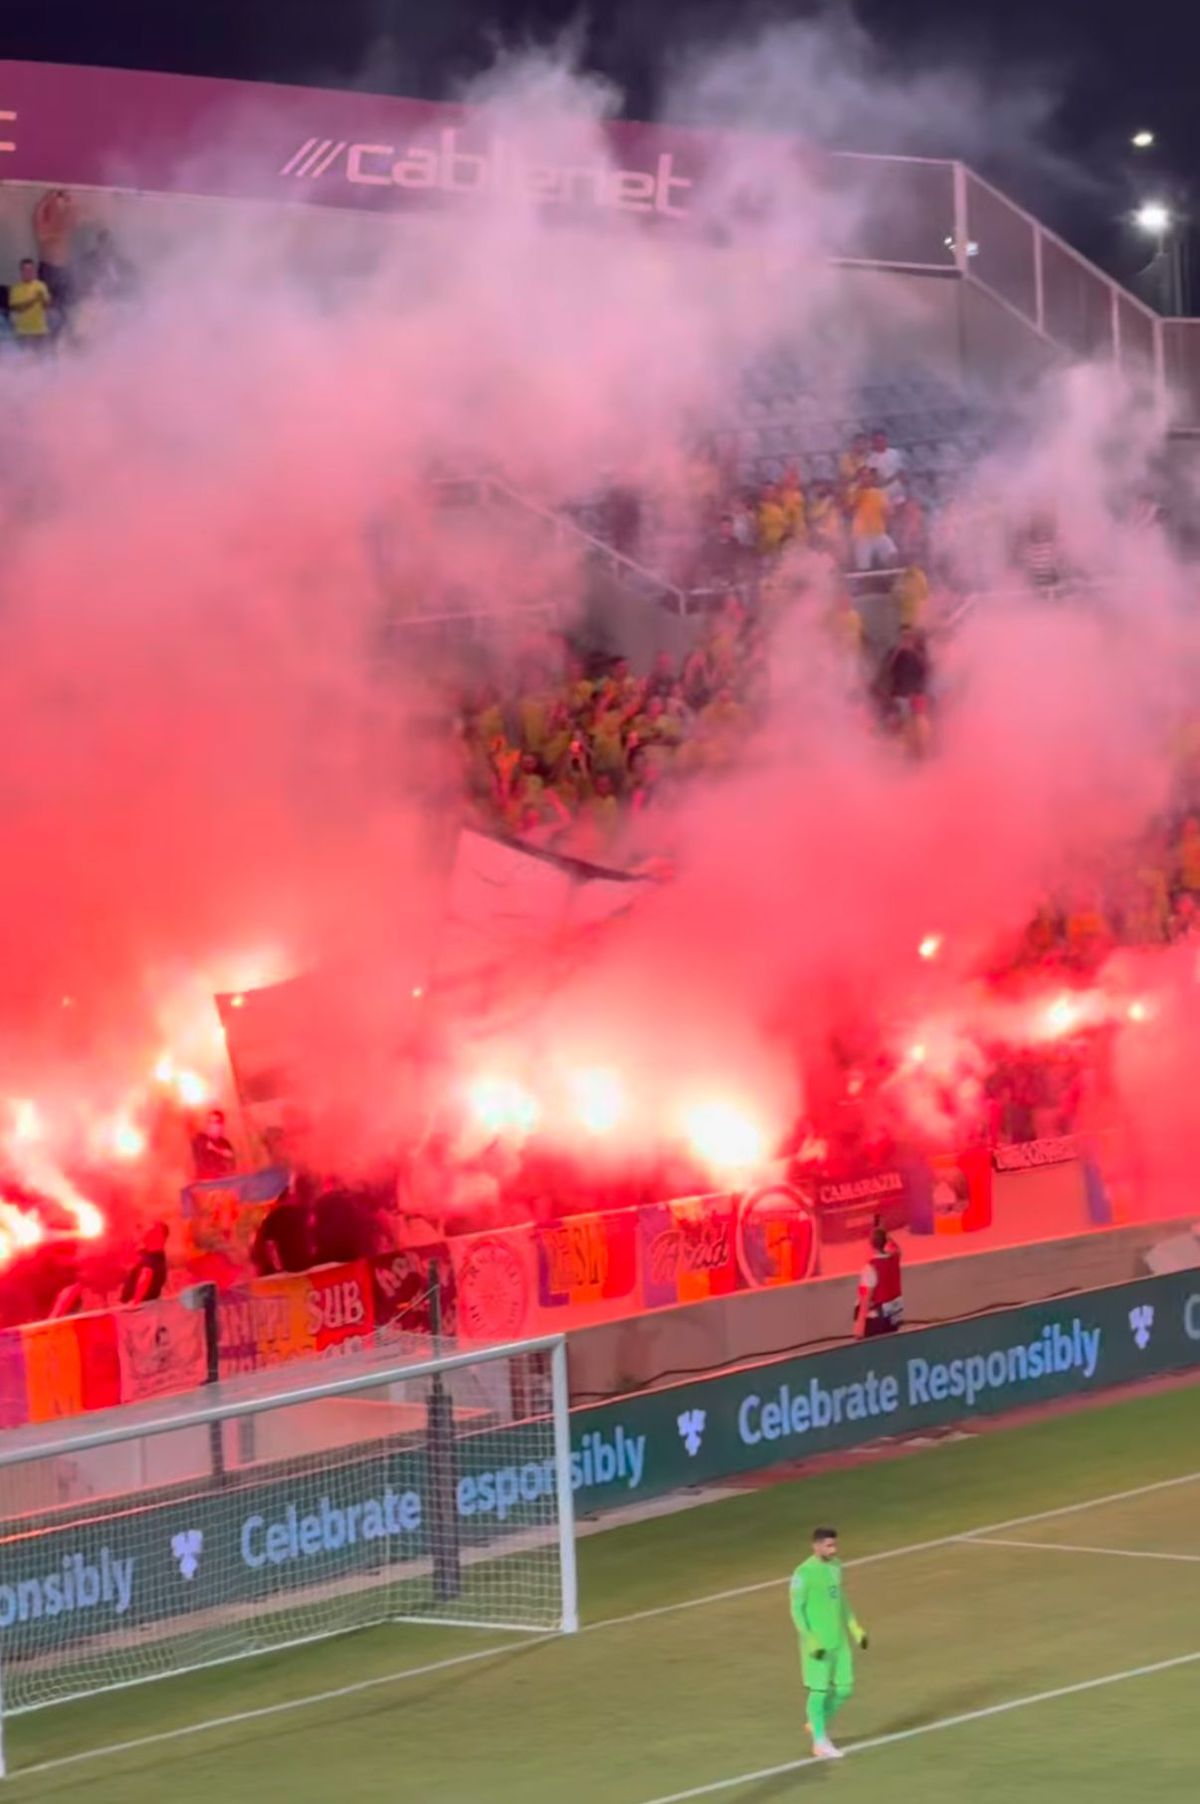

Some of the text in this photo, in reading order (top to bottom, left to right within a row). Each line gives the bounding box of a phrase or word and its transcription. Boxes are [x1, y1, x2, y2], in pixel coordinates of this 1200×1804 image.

[306, 1281, 365, 1335] SUB
[738, 1318, 1102, 1455] Celebrate Responsibly
[240, 1424, 646, 1567] Celebrate esponsibly
